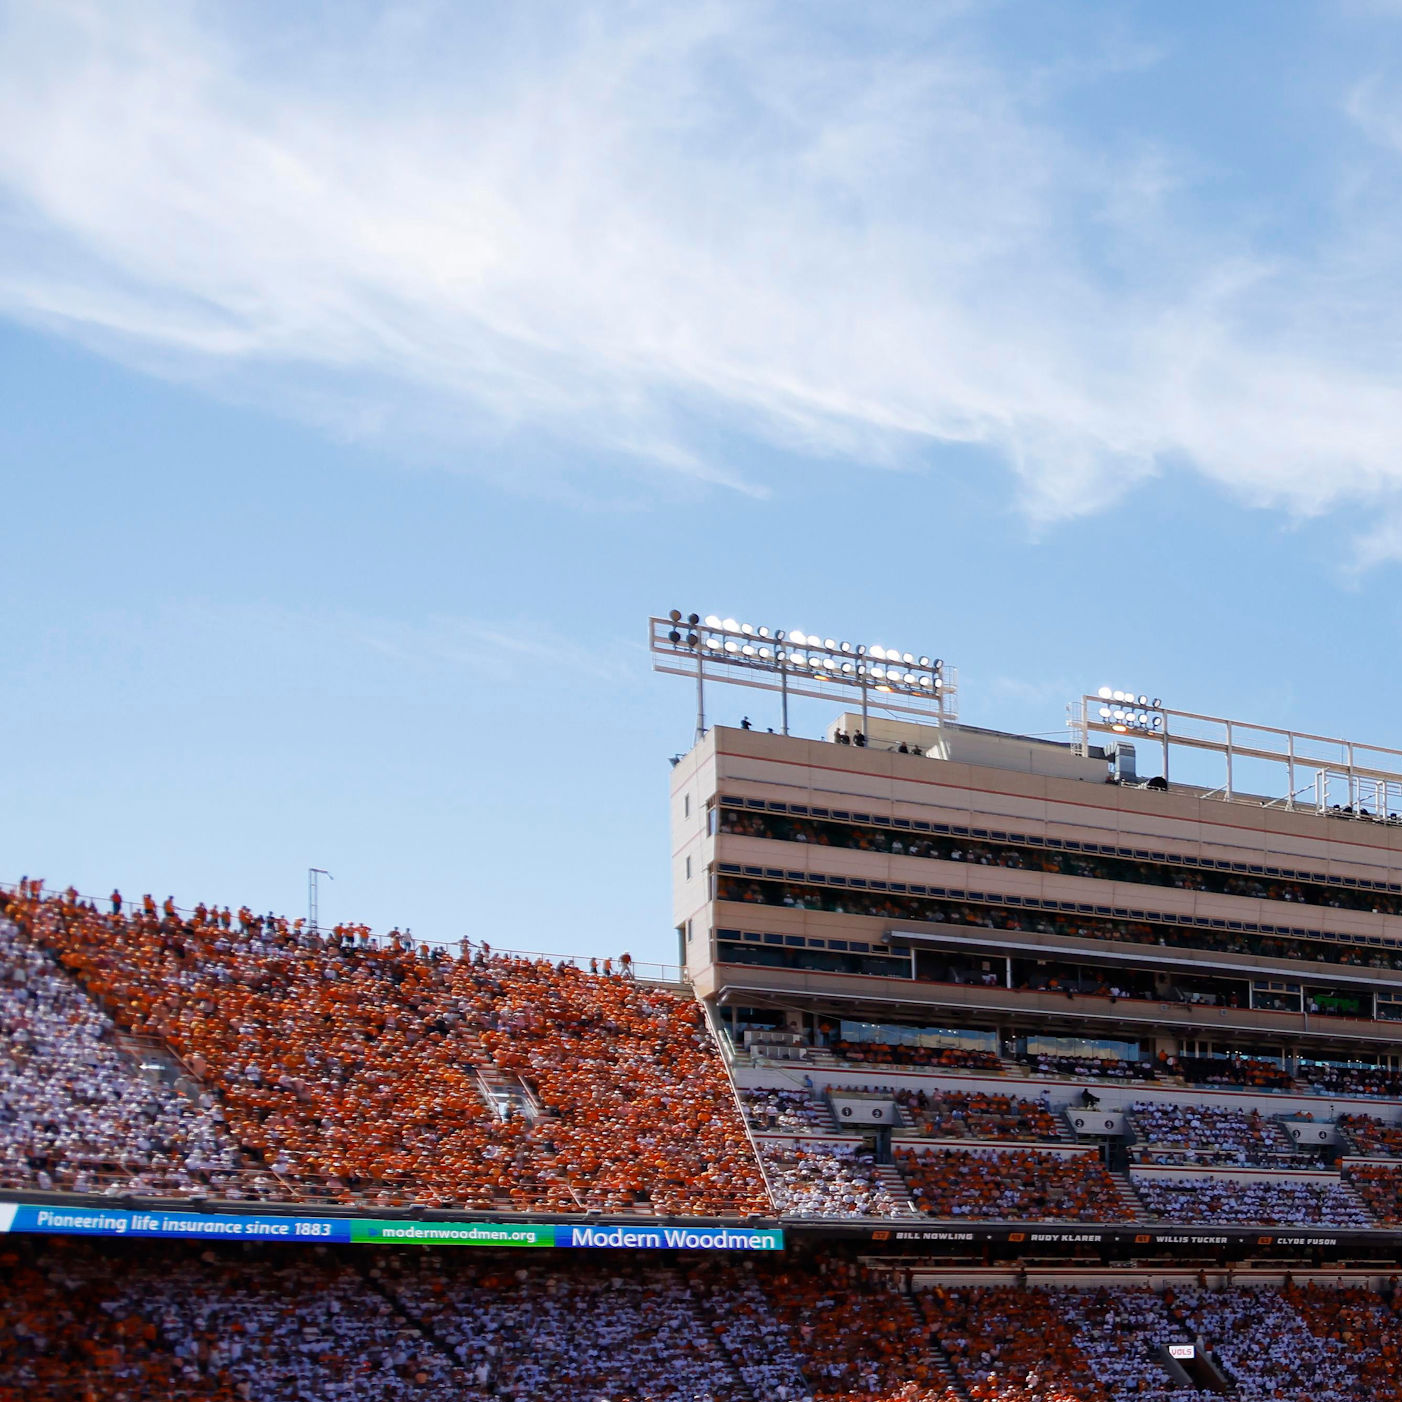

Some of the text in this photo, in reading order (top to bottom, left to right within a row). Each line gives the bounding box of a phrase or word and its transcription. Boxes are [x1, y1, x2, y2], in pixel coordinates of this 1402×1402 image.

[37, 1210, 332, 1237] Pioneering life insurance since 1883
[382, 1226, 536, 1244] modernwoodmen.org
[572, 1227, 775, 1249] Modern Woodmen
[896, 1232, 920, 1240] BILL
[1061, 1234, 1102, 1242] KLARER
[1191, 1236, 1228, 1244] TUCKER
[1277, 1237, 1305, 1245] CLYDE
